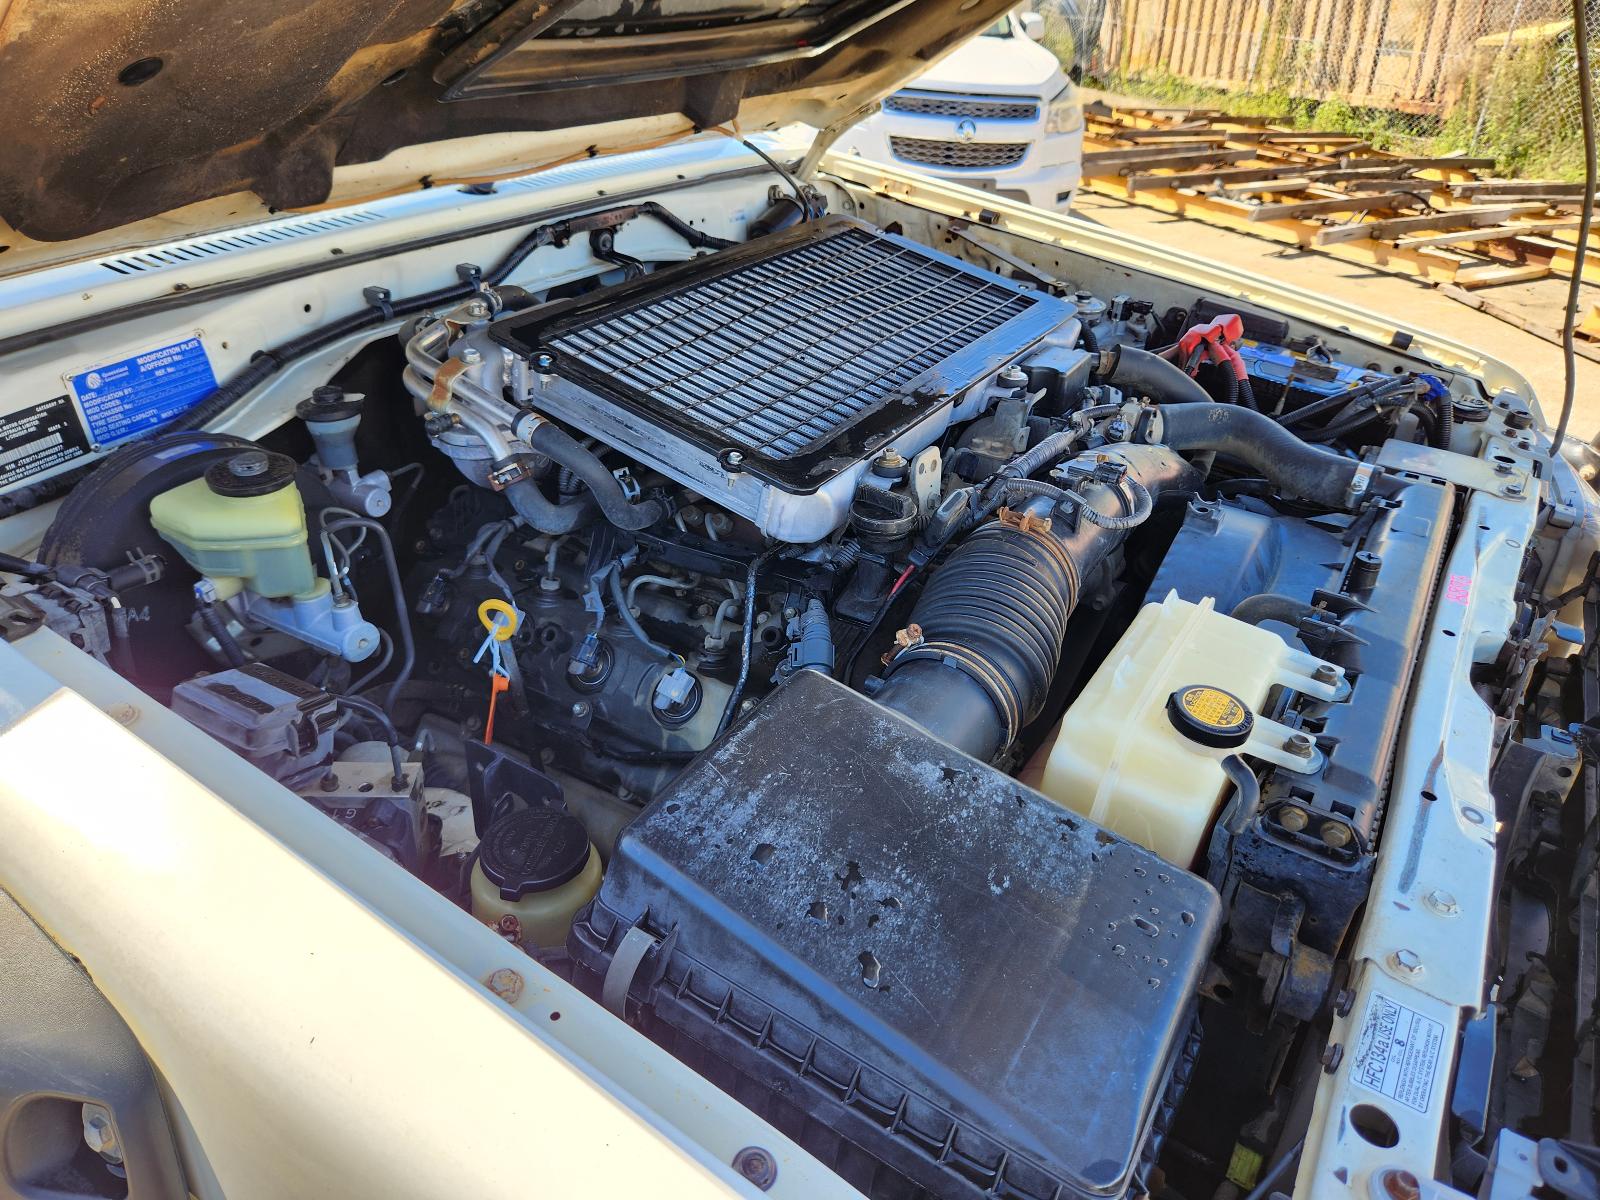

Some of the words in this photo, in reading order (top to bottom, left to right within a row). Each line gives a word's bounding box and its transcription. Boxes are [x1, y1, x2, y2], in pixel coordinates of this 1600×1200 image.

[137, 346, 181, 365] MODIFICATION
[180, 340, 199, 351] PLATE
[80, 392, 97, 402] DATE:
[83, 391, 124, 409] MODIFICATION
[123, 387, 133, 395] BY:
[36, 401, 57, 412] CATEGORY
[86, 406, 100, 415] MOD
[100, 399, 121, 410] CODES:
[3, 422, 18, 431] MOTOR
[18, 411, 48, 424] CORPORATION
[47, 423, 61, 432] SEATS
[91, 419, 106, 428] TYRE
[94, 426, 108, 435] MOD
[108, 418, 131, 430] SEATING
[1381, 1001, 1398, 1025] ONLY
[1377, 1021, 1393, 1040] USE
[1394, 1038, 1405, 1047] 8
[1364, 1039, 1390, 1088] HFC134a
